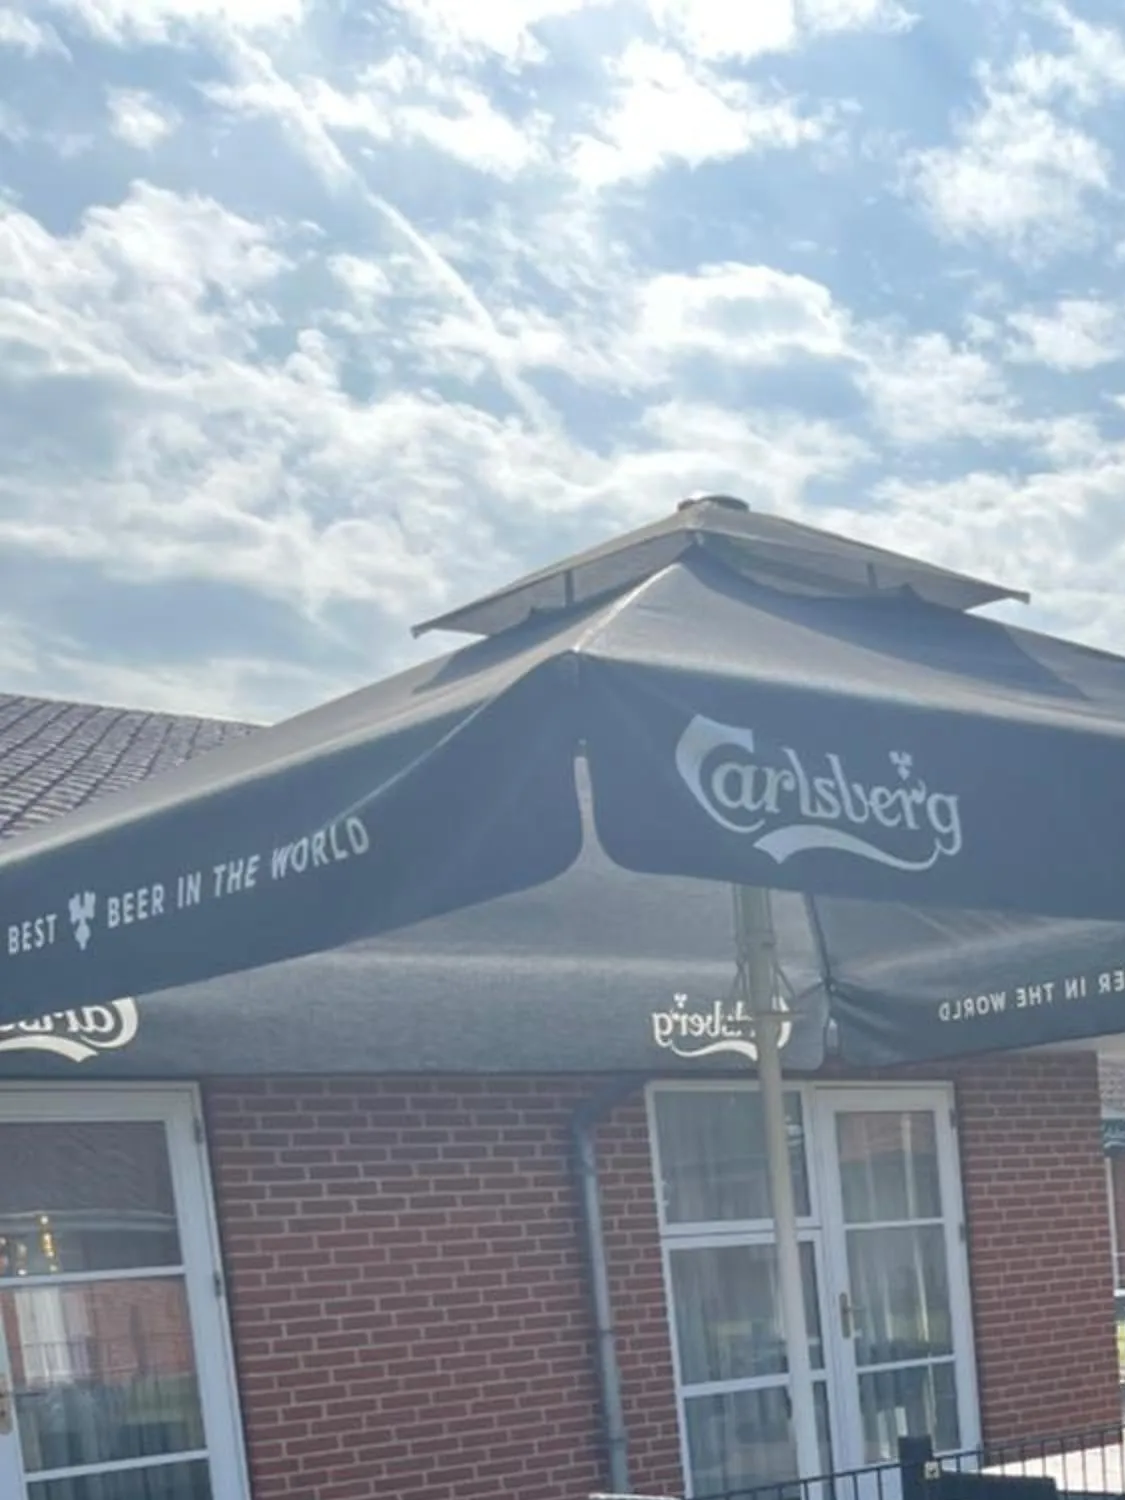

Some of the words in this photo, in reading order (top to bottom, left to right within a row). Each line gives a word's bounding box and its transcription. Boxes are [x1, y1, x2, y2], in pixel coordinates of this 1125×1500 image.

[675, 713, 963, 871] Carlsberg
[8, 913, 57, 955] BEST
[107, 883, 165, 928] BEER
[177, 871, 202, 909] IN
[213, 854, 260, 897] THE
[271, 816, 370, 880] WORLD
